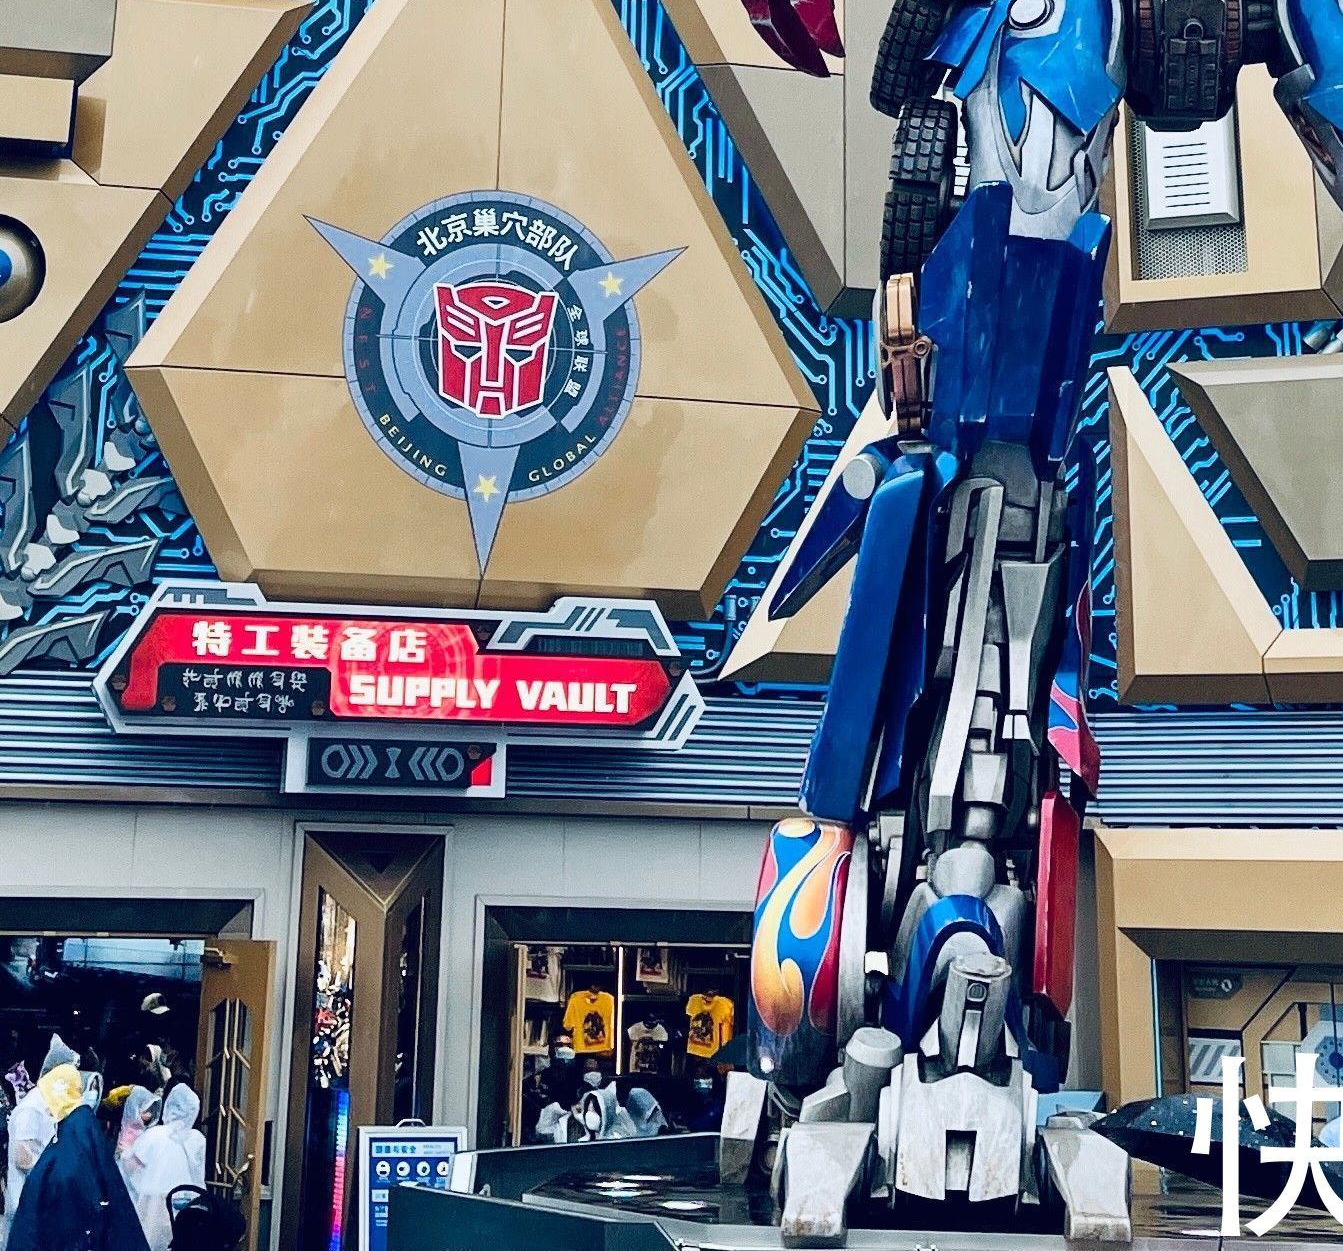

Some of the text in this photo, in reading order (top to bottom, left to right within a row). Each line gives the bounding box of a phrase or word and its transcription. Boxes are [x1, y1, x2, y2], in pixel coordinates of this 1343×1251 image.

[416, 208, 580, 271] 北京巢穴部队
[564, 304, 589, 402] 全球联盟
[379, 414, 448, 478] BEIJING
[528, 433, 596, 484] GLOBAL
[349, 677, 638, 715] SUPPLY VAULT
